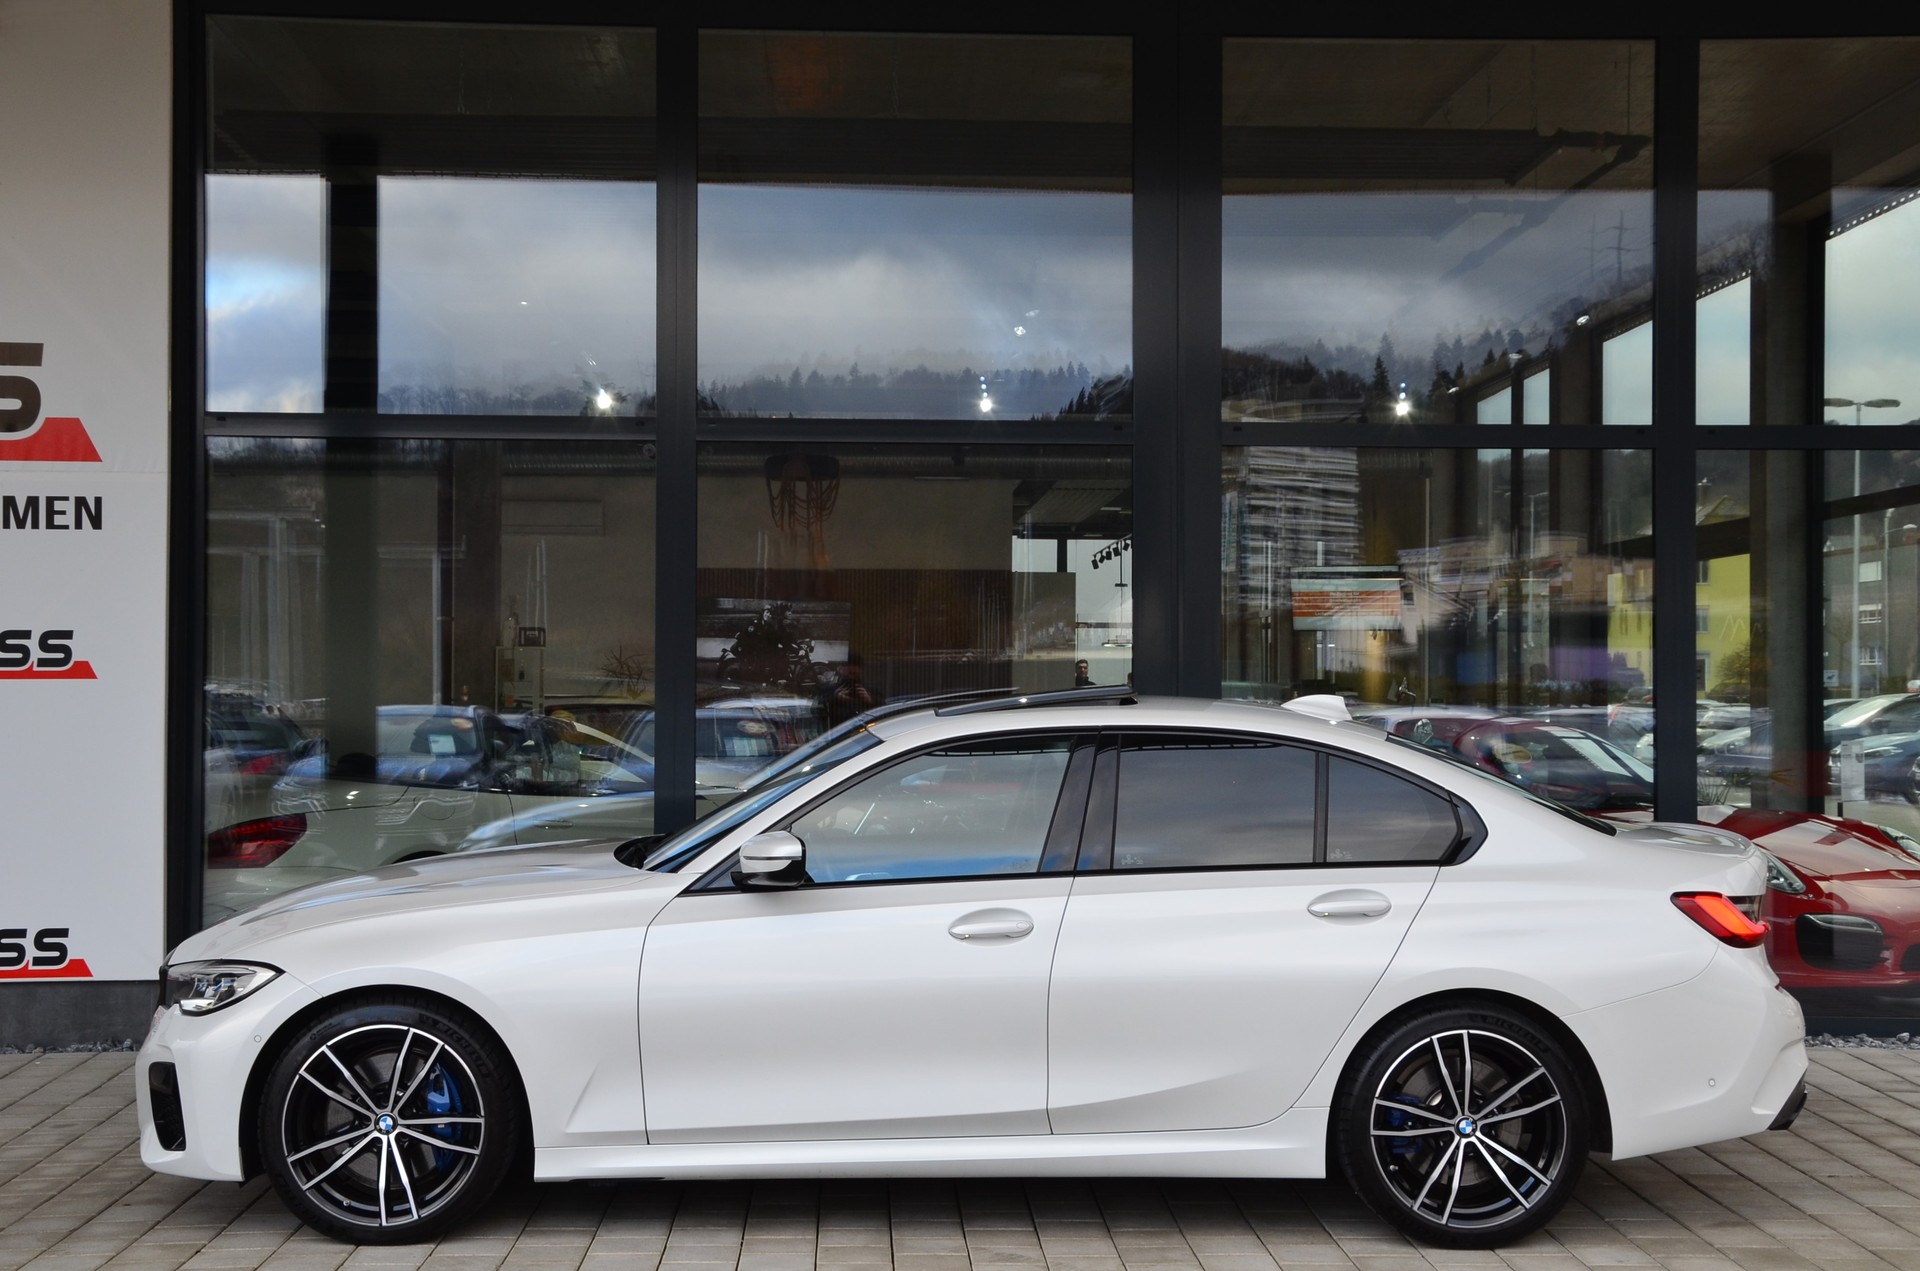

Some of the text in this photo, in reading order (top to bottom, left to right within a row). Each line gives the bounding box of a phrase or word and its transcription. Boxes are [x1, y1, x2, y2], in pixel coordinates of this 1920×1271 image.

[2, 496, 102, 530] MEN
[0, 629, 73, 667] SS
[0, 927, 69, 967] SS
[436, 1021, 490, 1077] MICHELIN
